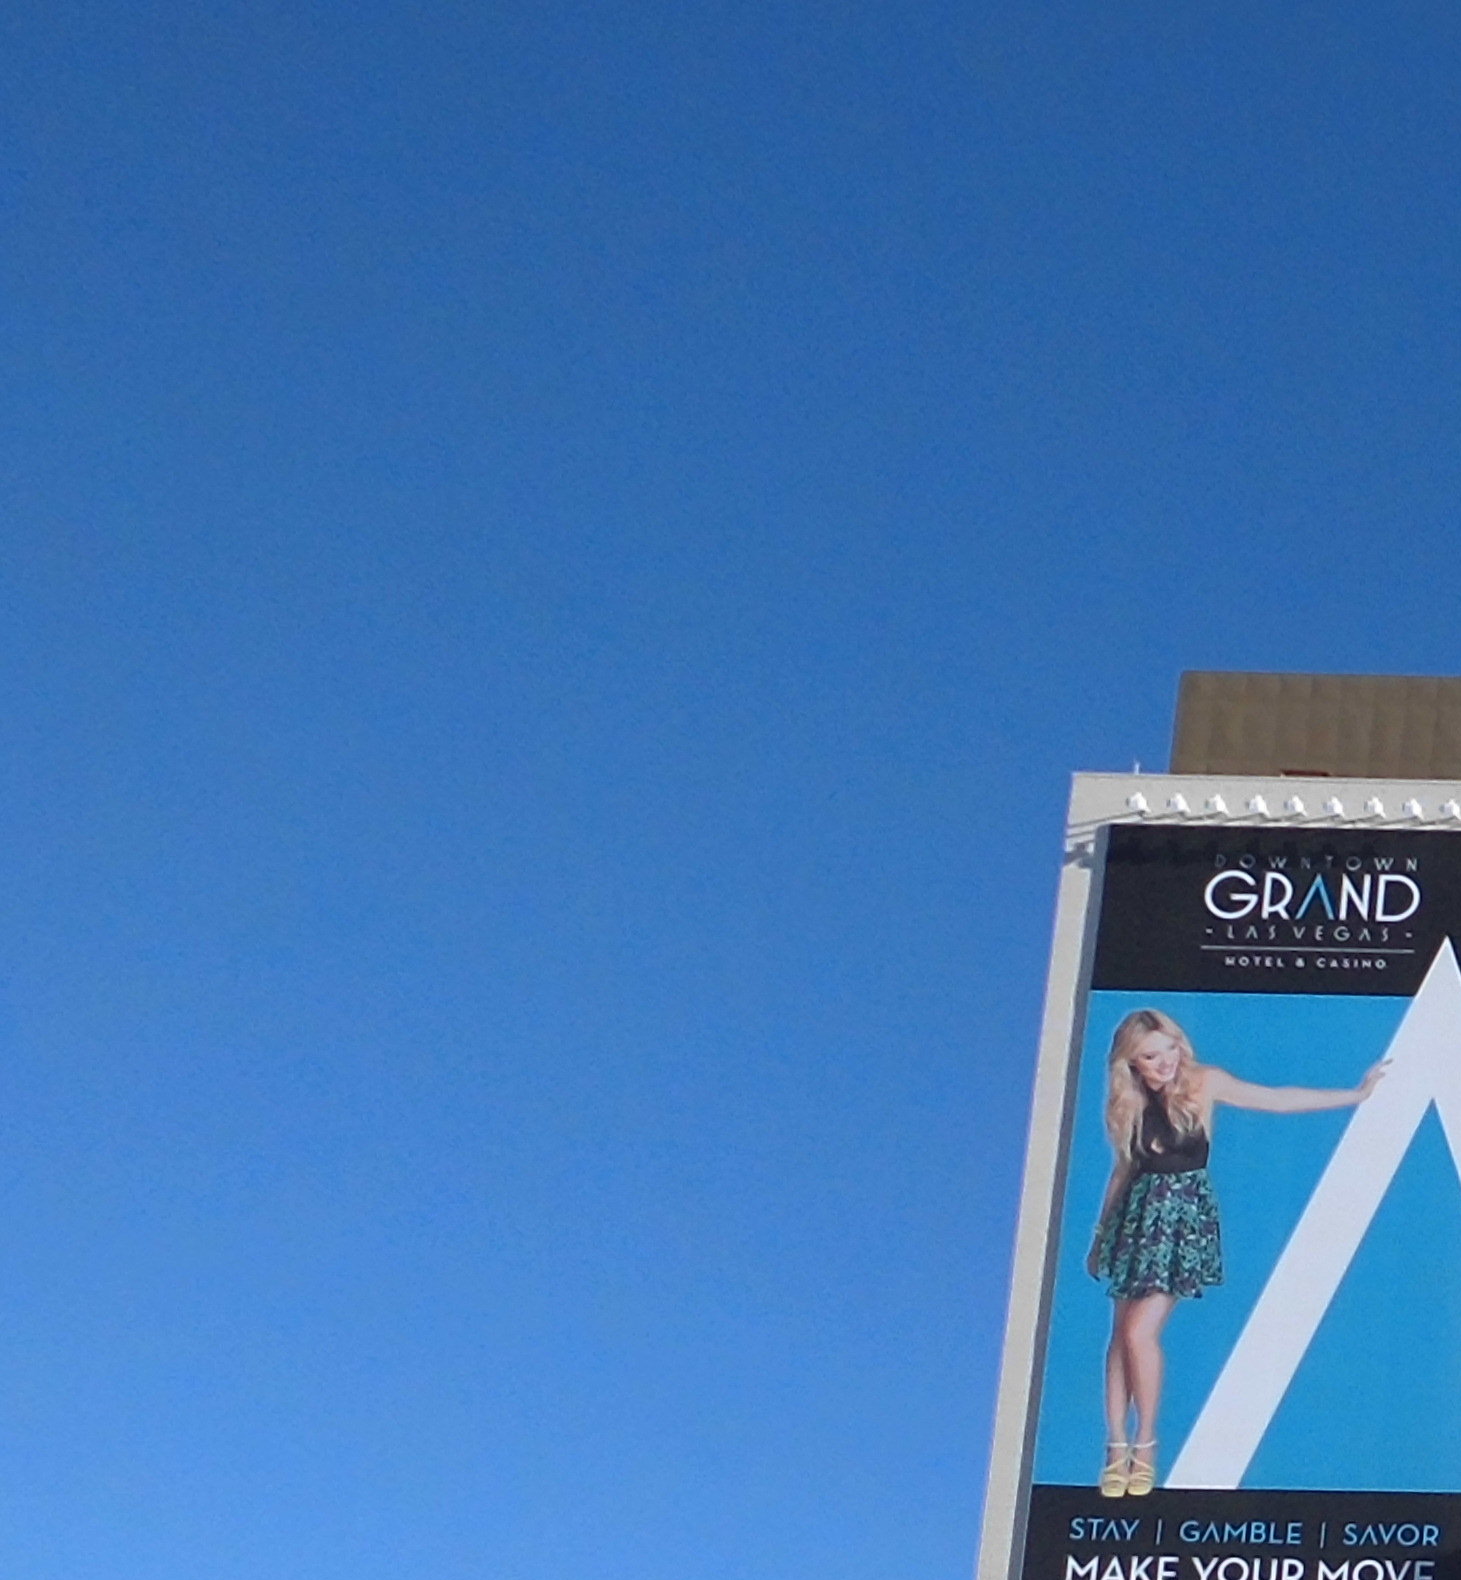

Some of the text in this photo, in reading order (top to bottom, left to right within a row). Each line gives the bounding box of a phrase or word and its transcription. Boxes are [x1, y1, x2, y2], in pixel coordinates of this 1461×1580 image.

[1214, 854, 1418, 871] DOWNTOWN
[1204, 870, 1421, 922] GRAND
[1227, 925, 1389, 942] LAS VEGAS
[1225, 956, 1286, 967] HOTEL
[1316, 957, 1387, 969] CASINO
[1069, 1518, 1441, 1547] STAY GAMBLE SAVOR
